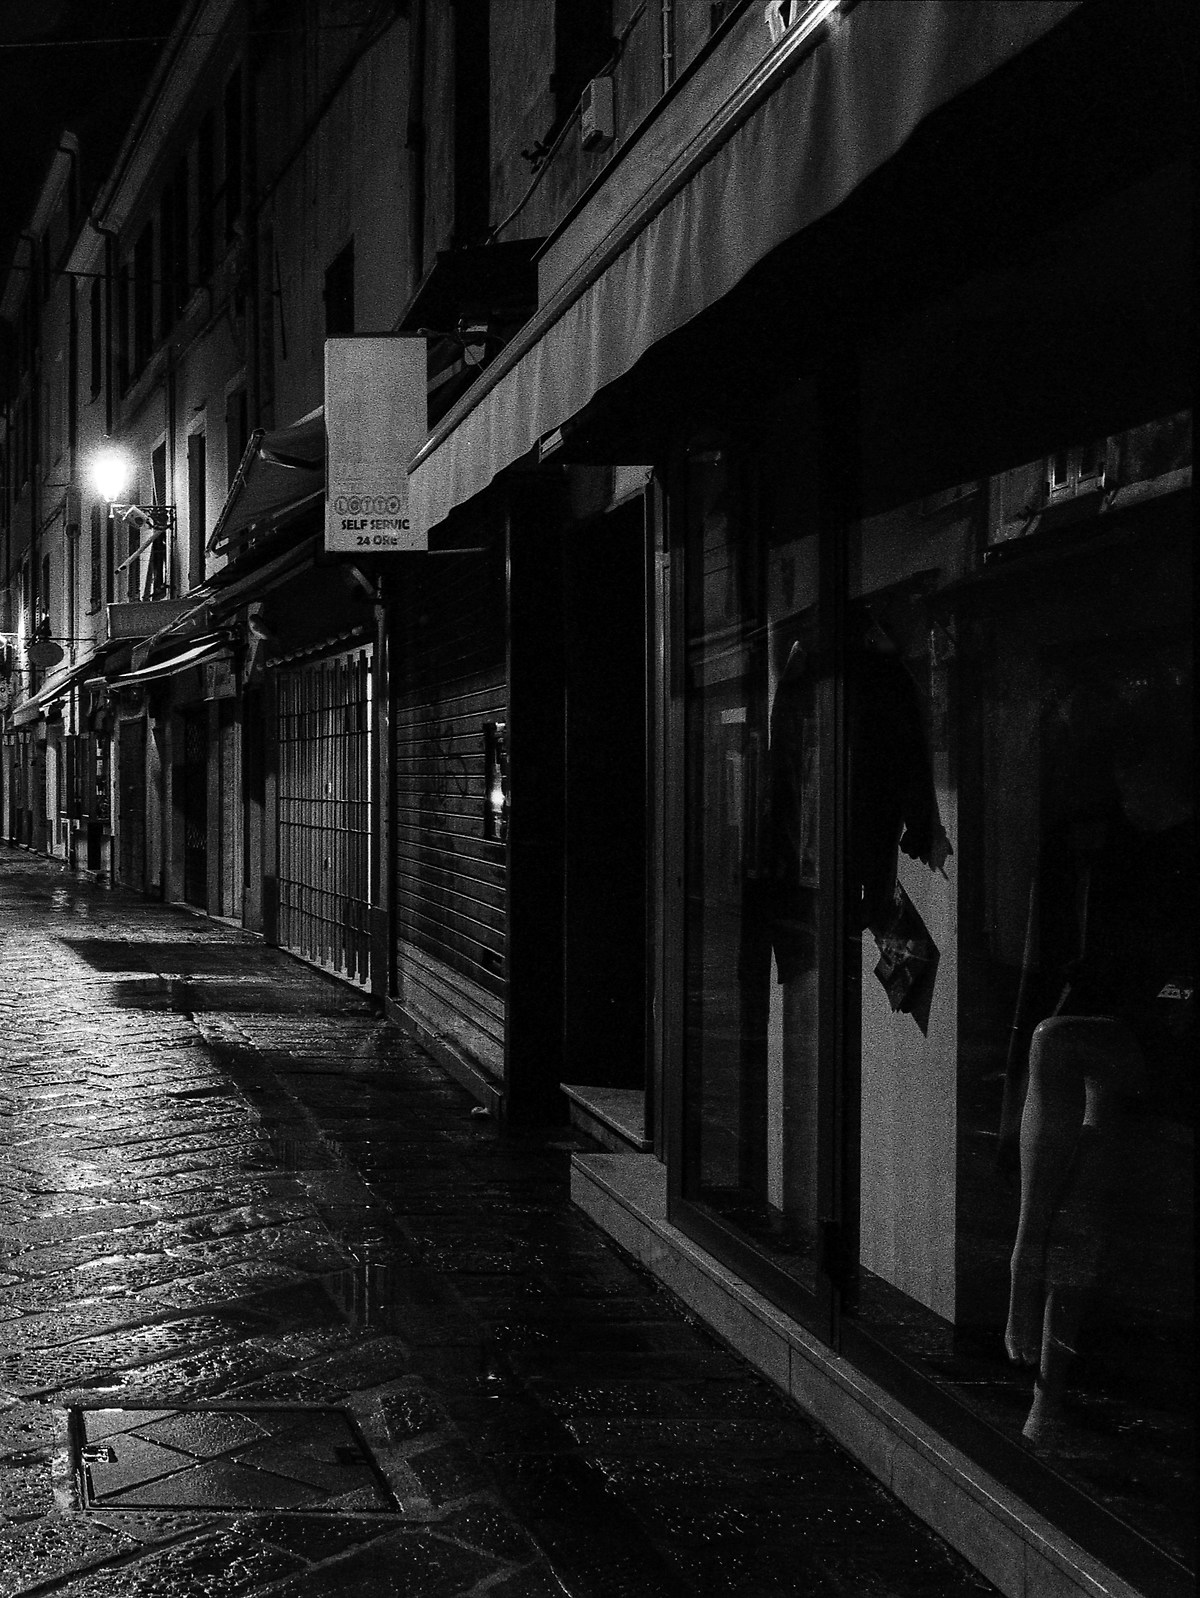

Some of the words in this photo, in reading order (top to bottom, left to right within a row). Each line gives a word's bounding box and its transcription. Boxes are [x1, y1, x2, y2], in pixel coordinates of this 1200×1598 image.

[341, 519, 367, 530] SELF
[370, 519, 410, 530] SERVIC
[356, 536, 370, 546] 24
